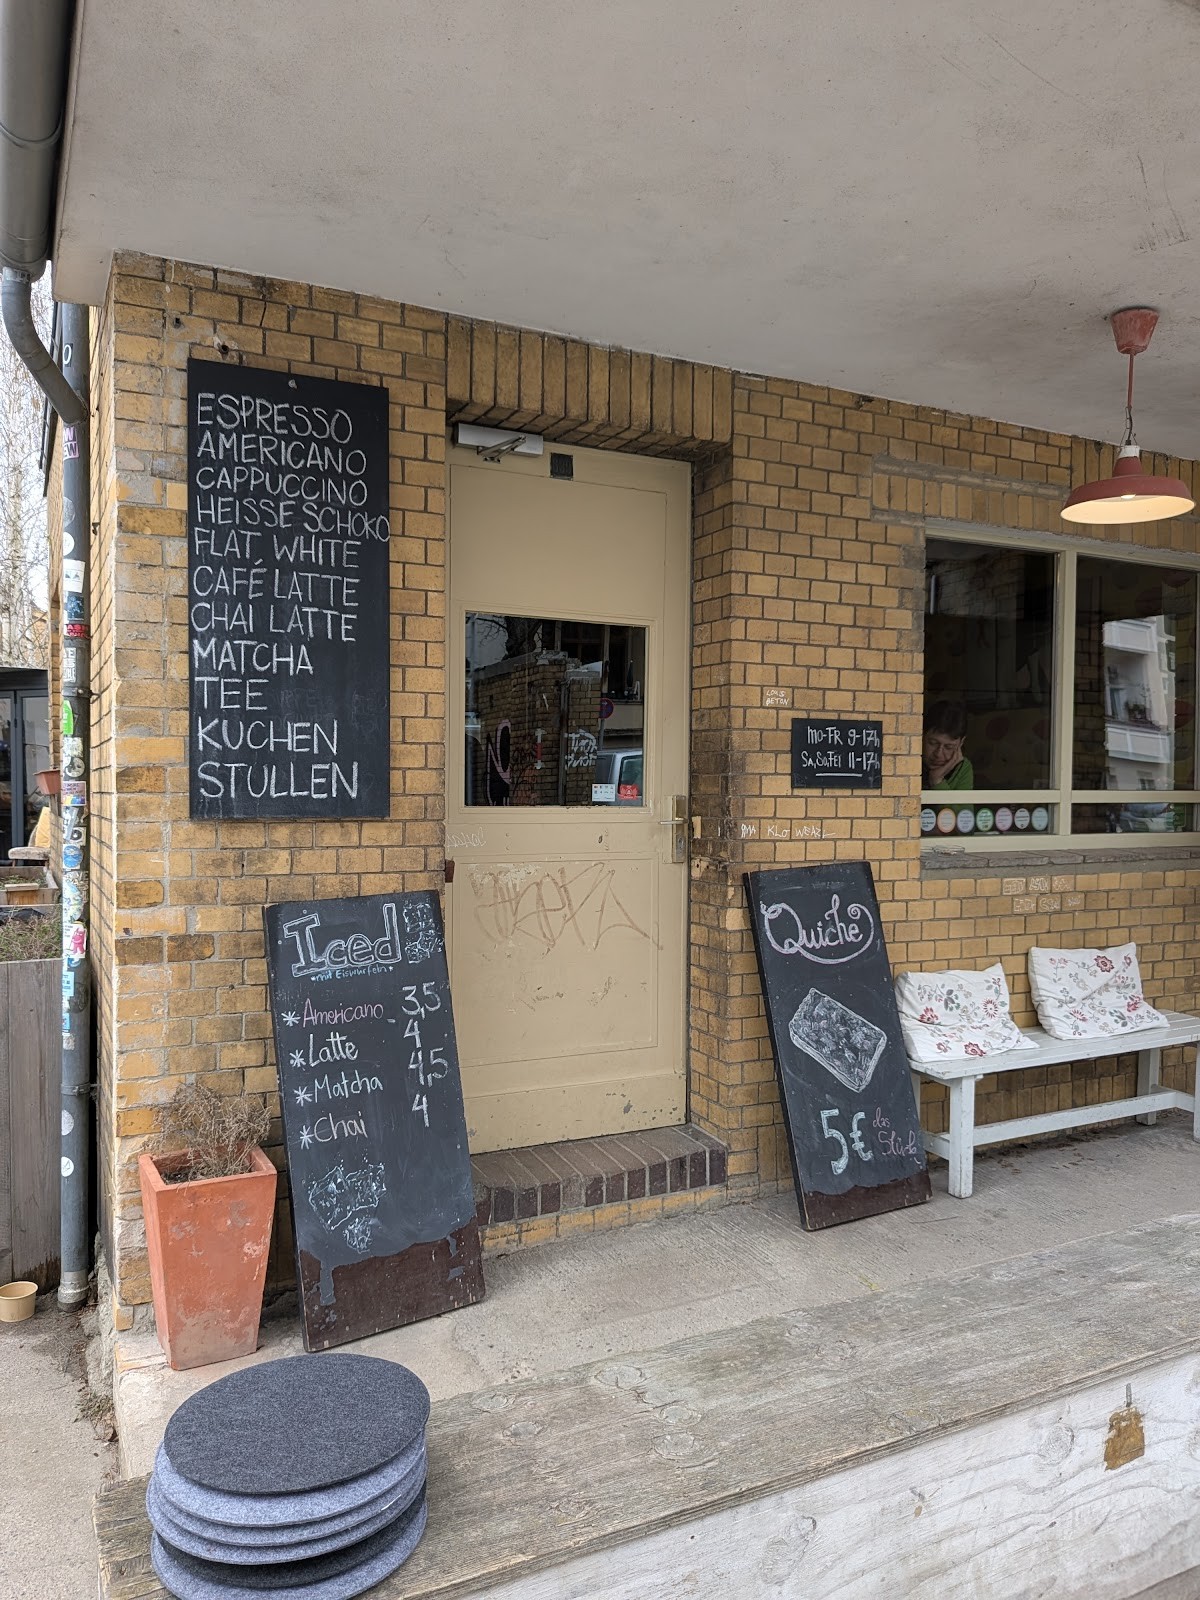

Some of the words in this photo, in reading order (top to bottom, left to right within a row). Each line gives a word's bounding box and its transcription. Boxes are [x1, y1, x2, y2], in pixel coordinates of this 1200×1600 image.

[197, 393, 352, 444] ESPRESSO
[197, 430, 366, 476] AMERICANO
[196, 466, 368, 507] CAPPUCCINO
[197, 494, 296, 528] HEISSE
[302, 502, 391, 542] SCHOKO
[194, 527, 262, 559] FLAT
[273, 534, 361, 568] WHITE
[193, 558, 267, 600] CAFÉ
[274, 568, 360, 607] LATTE
[191, 601, 254, 634] CHAI
[269, 604, 357, 642] LATTE
[193, 638, 314, 676] MATCHA
[195, 677, 269, 711] TEE
[198, 716, 337, 756] KUCHEN
[198, 761, 358, 799] STULLEN
[283, 903, 401, 977] Iced
[760, 893, 874, 964] Quiche
[302, 998, 384, 1028] Americano
[401, 981, 442, 1019] 3,5
[308, 1032, 359, 1067] Latte
[403, 1019, 422, 1048] 4
[313, 1070, 383, 1103] Matcha
[407, 1047, 449, 1087] 4,5
[313, 1111, 368, 1142] Chai
[412, 1094, 430, 1127] 4
[873, 1107, 890, 1127] das
